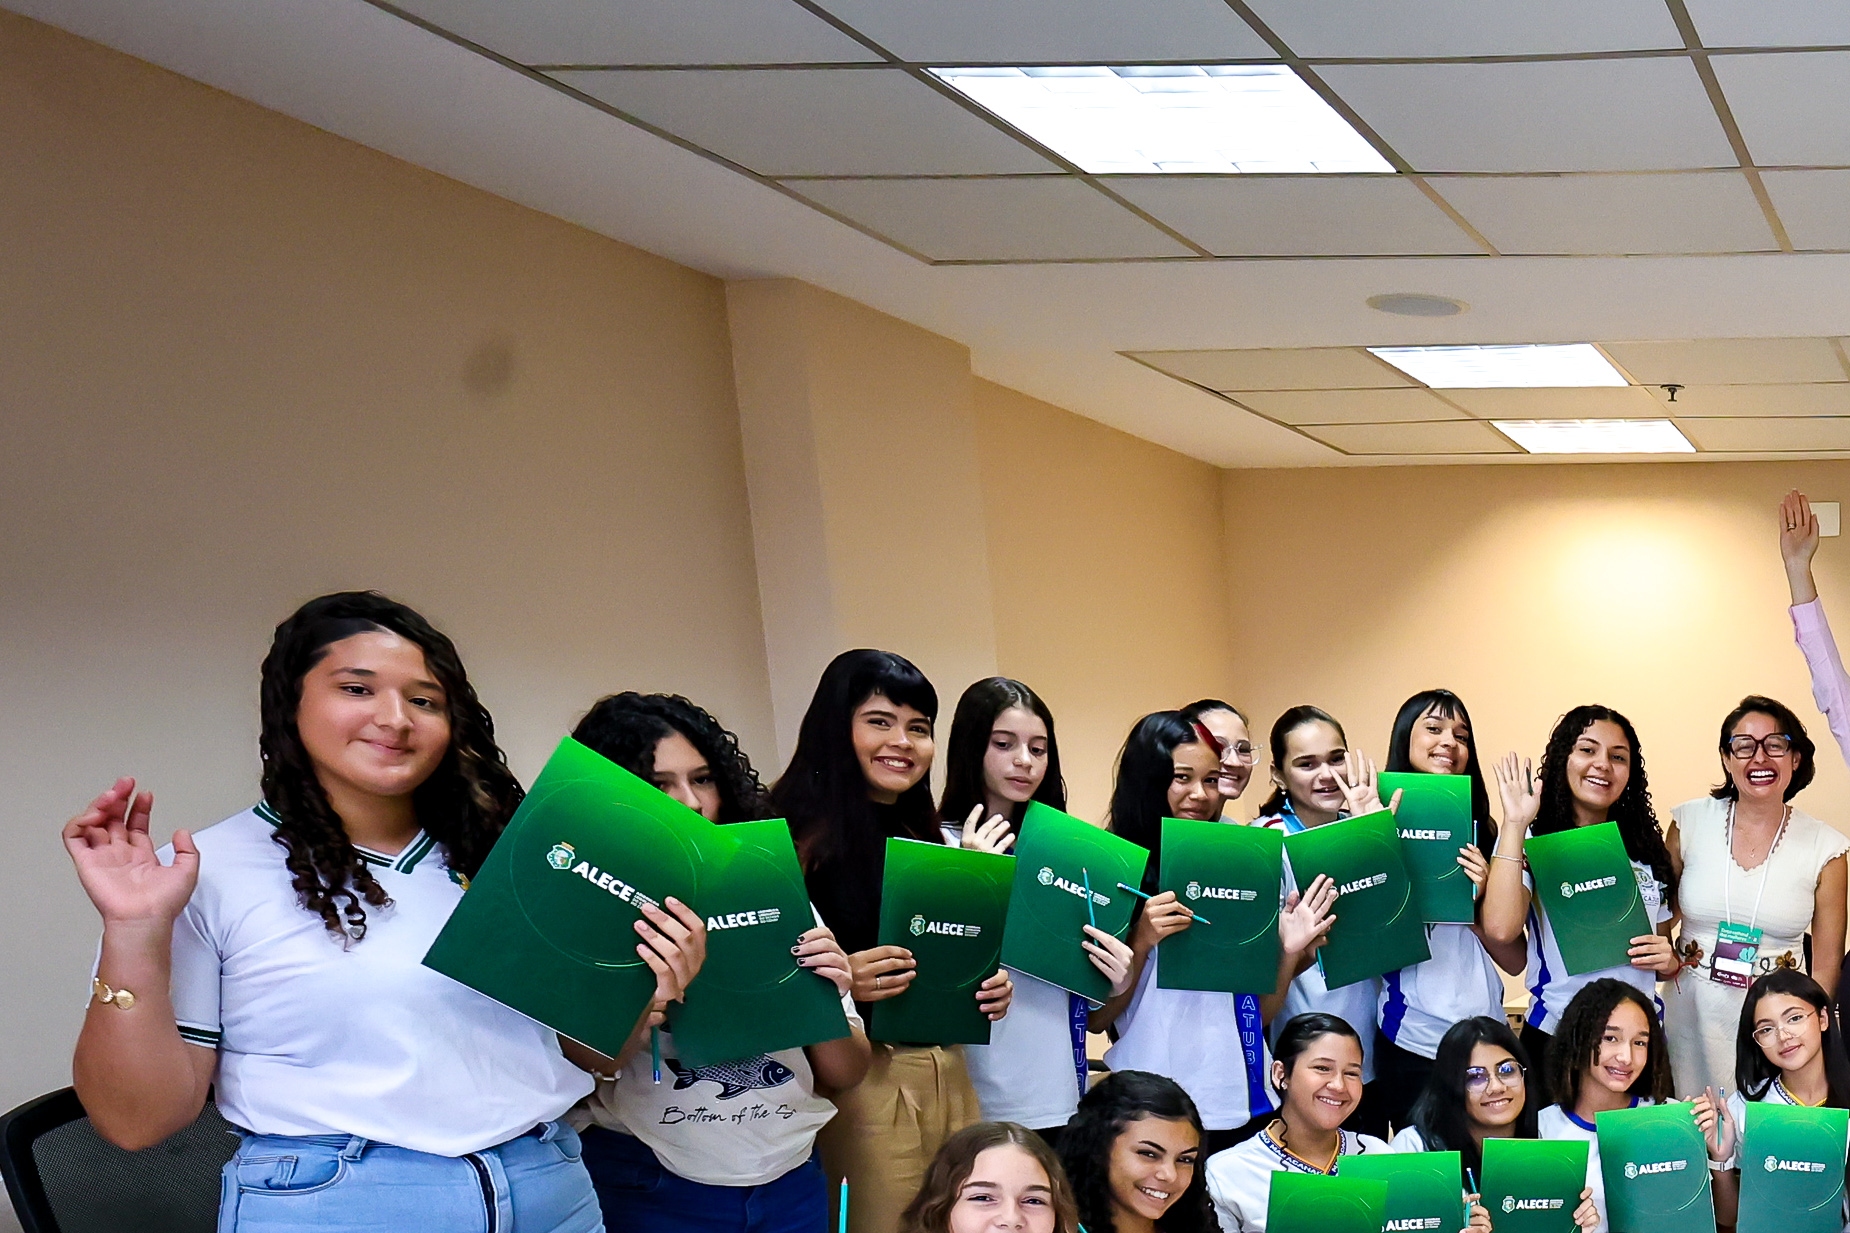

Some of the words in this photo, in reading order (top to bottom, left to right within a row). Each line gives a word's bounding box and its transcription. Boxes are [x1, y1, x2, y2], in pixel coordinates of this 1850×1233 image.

[1401, 828, 1436, 840] ALECE
[571, 861, 635, 902] ALECE
[1340, 876, 1374, 896] ALECE
[1574, 878, 1604, 894] ALECE
[1201, 886, 1240, 900] ALECE
[706, 910, 759, 932] ALECE
[926, 921, 965, 937] ALECE
[659, 1106, 727, 1125] Bottom
[731, 1106, 748, 1125] of
[749, 1104, 770, 1122] the
[1638, 1161, 1673, 1175] ALECE
[1777, 1159, 1811, 1172] ALECE
[1515, 1198, 1550, 1210] ALECE
[1386, 1218, 1424, 1232] ALECE
